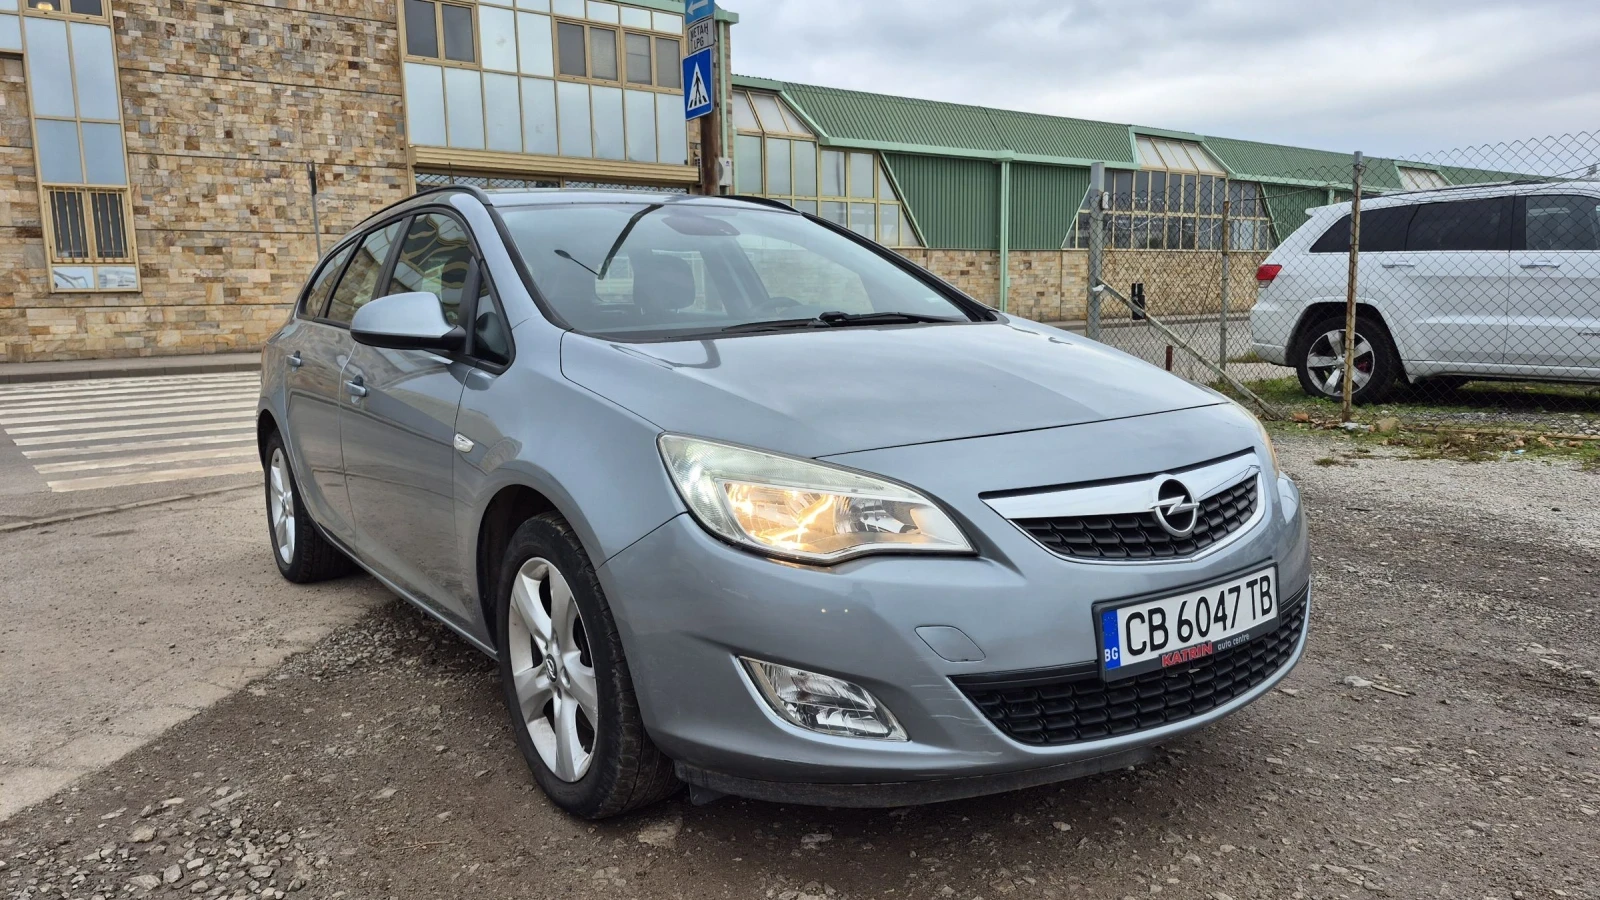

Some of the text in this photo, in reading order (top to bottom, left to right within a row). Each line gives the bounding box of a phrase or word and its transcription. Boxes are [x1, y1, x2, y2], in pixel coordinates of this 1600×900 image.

[693, 36, 704, 49] LPG
[1125, 575, 1273, 656] CB 6047 TB
[1105, 647, 1119, 662] BG
[1162, 633, 1250, 667] KATRIN auto centre
